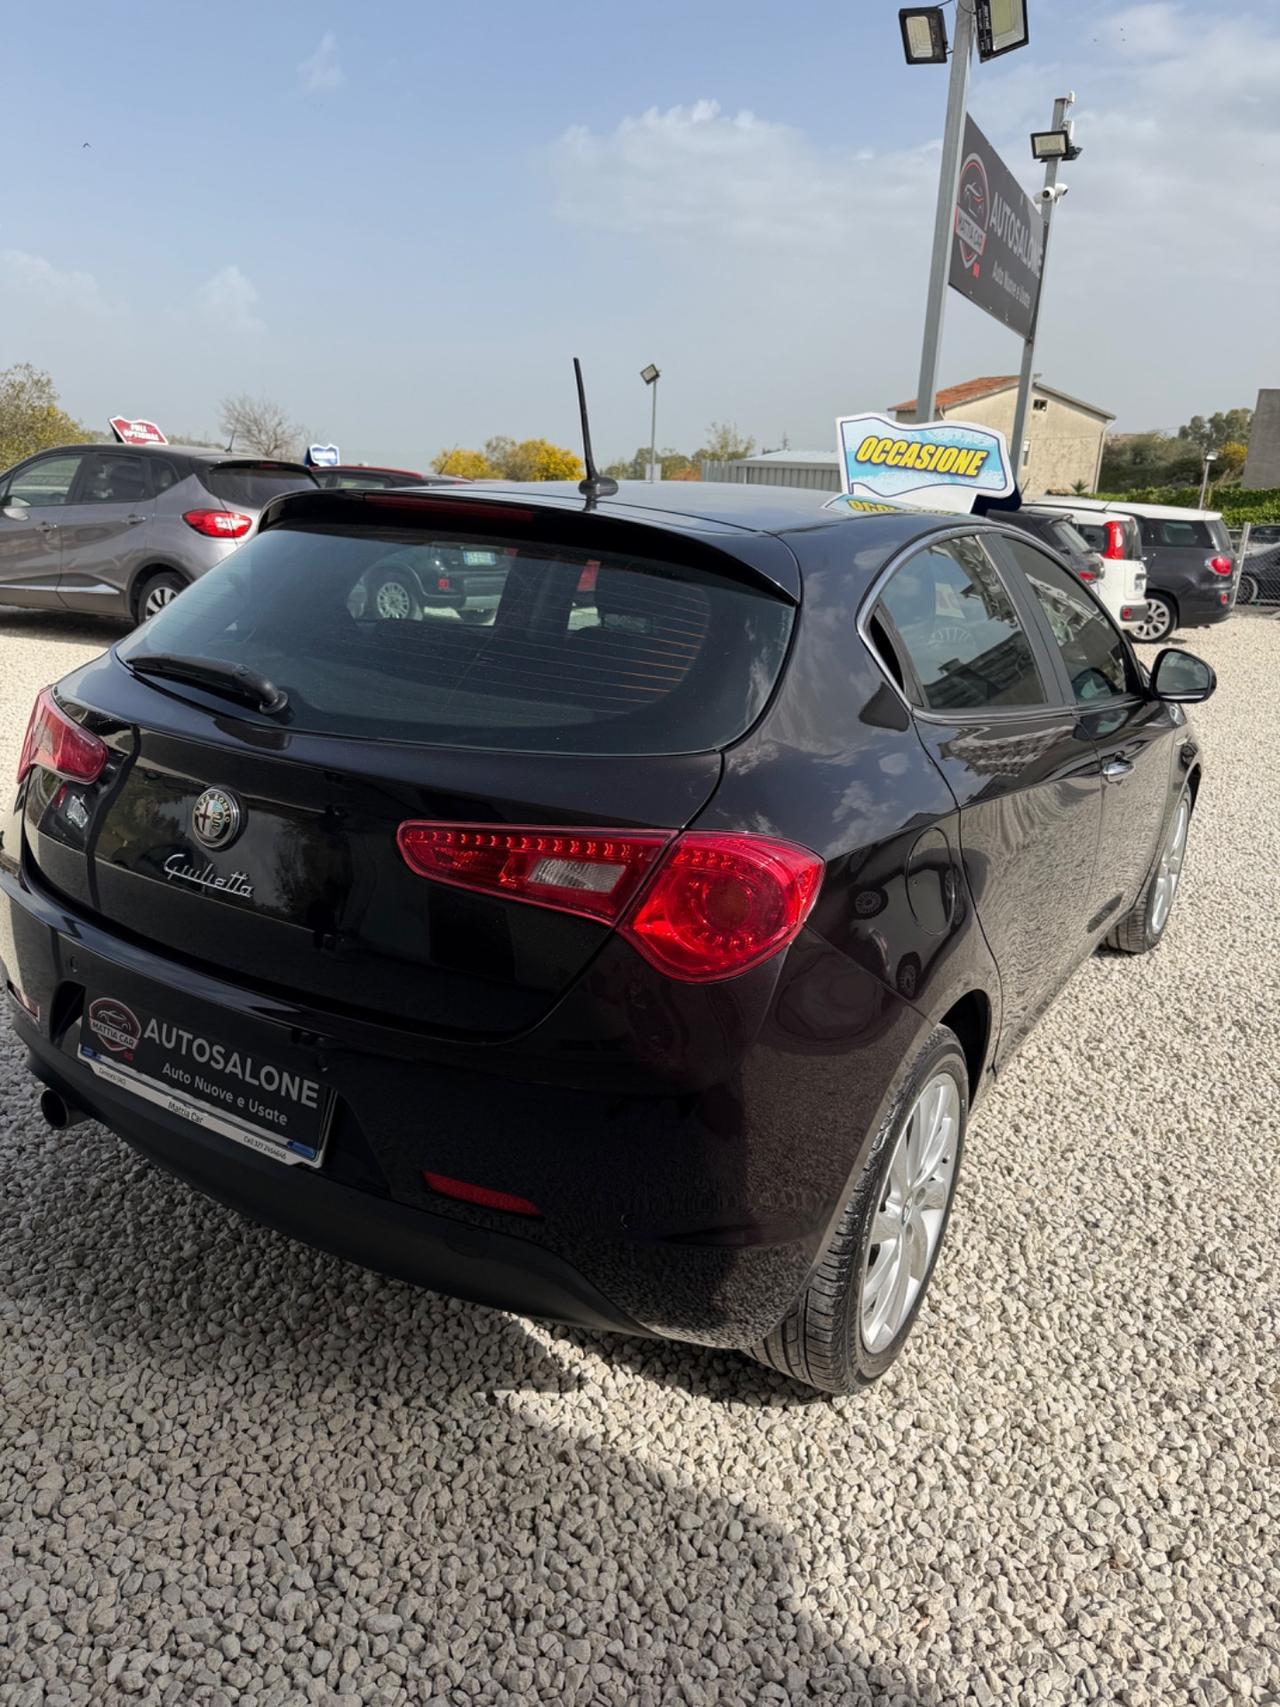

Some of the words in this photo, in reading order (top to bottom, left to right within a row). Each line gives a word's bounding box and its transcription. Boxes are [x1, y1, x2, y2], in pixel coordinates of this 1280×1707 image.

[989, 191, 1043, 280] AUTOSALONE
[123, 429, 159, 441] OPTIONAL
[131, 424, 147, 433] FULL
[855, 435, 989, 477] OCCASIONE
[164, 853, 253, 898] Giulietta
[93, 1021, 118, 1039] MATTIA
[118, 1033, 134, 1047] CAR
[144, 1018, 320, 1109] AUTOSALONE
[162, 1062, 192, 1084] Auto
[194, 1074, 234, 1102] Nuove
[236, 1096, 246, 1108] e
[249, 1100, 288, 1126] Usate
[168, 1100, 191, 1119] Mattia
[190, 1109, 204, 1124] Car
